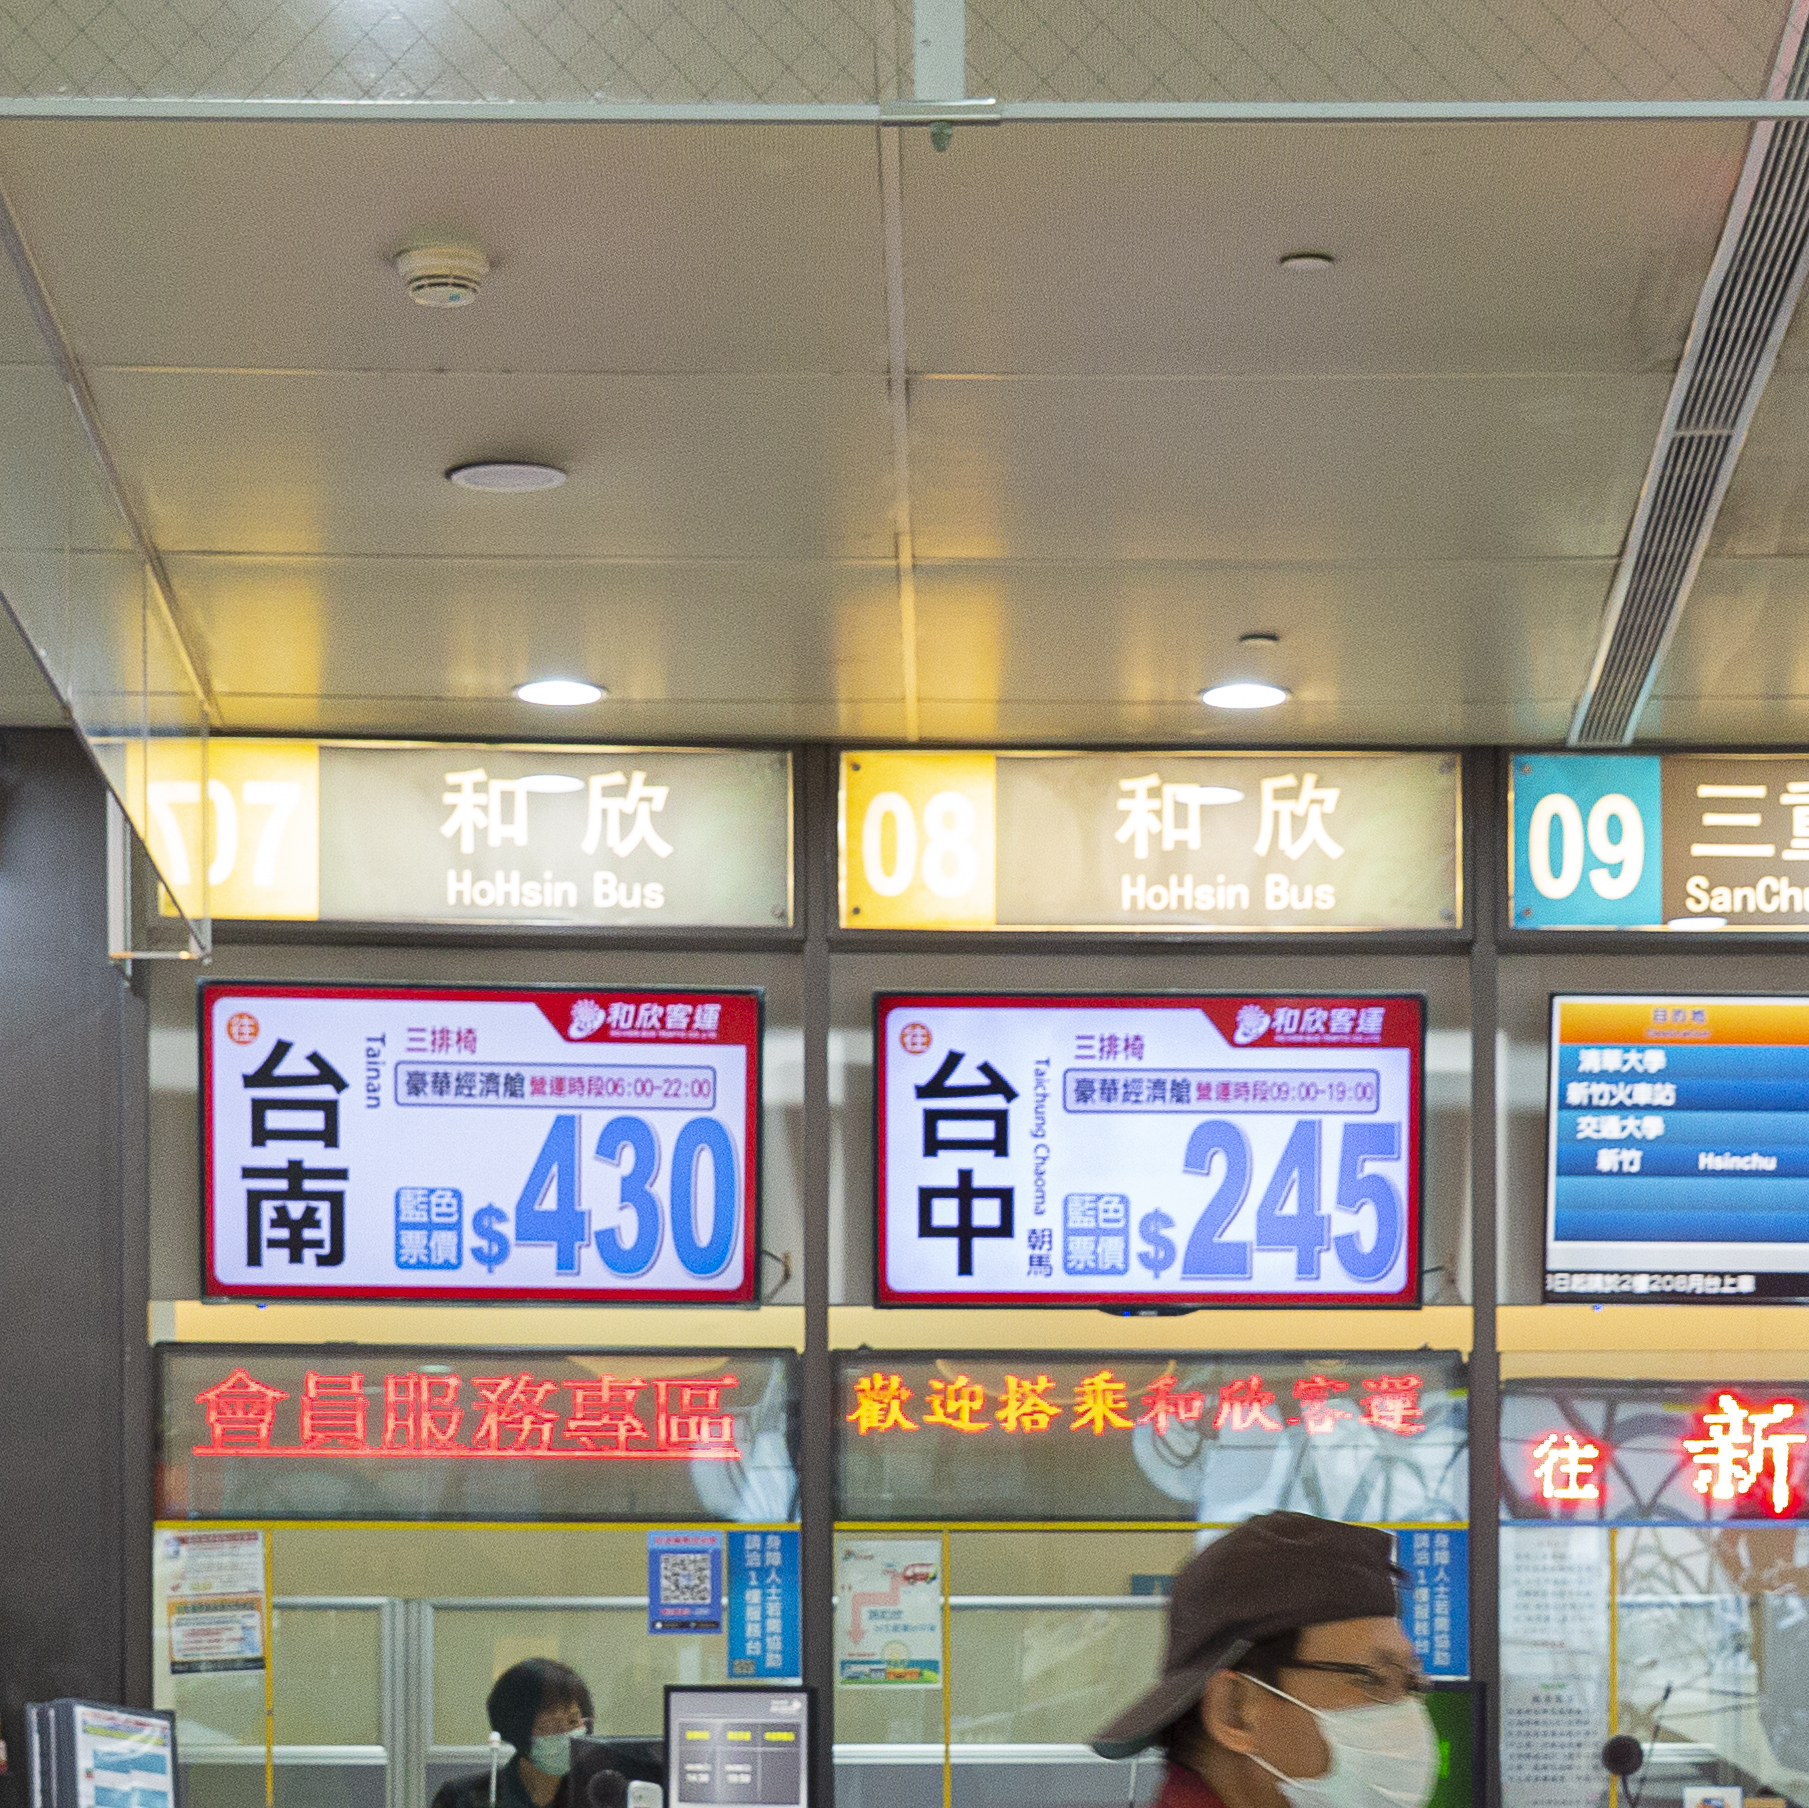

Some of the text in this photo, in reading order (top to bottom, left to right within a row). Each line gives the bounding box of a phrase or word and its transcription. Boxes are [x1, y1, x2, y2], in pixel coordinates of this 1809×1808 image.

[440, 768, 673, 858] 和欣
[1114, 772, 1345, 861] 和欣
[860, 790, 978, 898] 08
[1528, 792, 1645, 901] 09
[445, 871, 665, 910] HoHsin Bus
[1121, 874, 1336, 911] HoHsin Bus
[229, 1015, 256, 1042] 往
[606, 1001, 722, 1031] 和欣客運
[1271, 1006, 1386, 1037] 和欣客運
[405, 1026, 478, 1055] 三排椅
[1074, 1033, 1145, 1063] 三排椅
[365, 1033, 387, 1109] Tainan
[1578, 1049, 1667, 1073] 清華大學
[405, 1071, 526, 1100] 豪華經濟艙
[1074, 1077, 1191, 1105] 豪華經濟艙
[1566, 1082, 1677, 1107] 新竹火車站
[1575, 1115, 1665, 1140] 交通大學
[241, 1039, 350, 1268] 台南
[915, 1049, 1020, 1278] 台中
[1027, 1057, 1053, 1278] Taichung Chaoma 朝馬
[1596, 1148, 1643, 1173] 新竹
[1697, 1151, 1777, 1172] Hsinchu
[397, 1189, 460, 1223] 藍色
[470, 1113, 740, 1279] $430
[1068, 1196, 1128, 1229] 藍色
[1137, 1118, 1403, 1284] $245
[397, 1229, 460, 1265] 票價
[1068, 1236, 1128, 1272] 票價
[196, 1367, 738, 1452] 會員服務專區
[846, 1370, 1426, 1437] 歡迎搭乘和欣客運
[1534, 1433, 1599, 1501] 往
